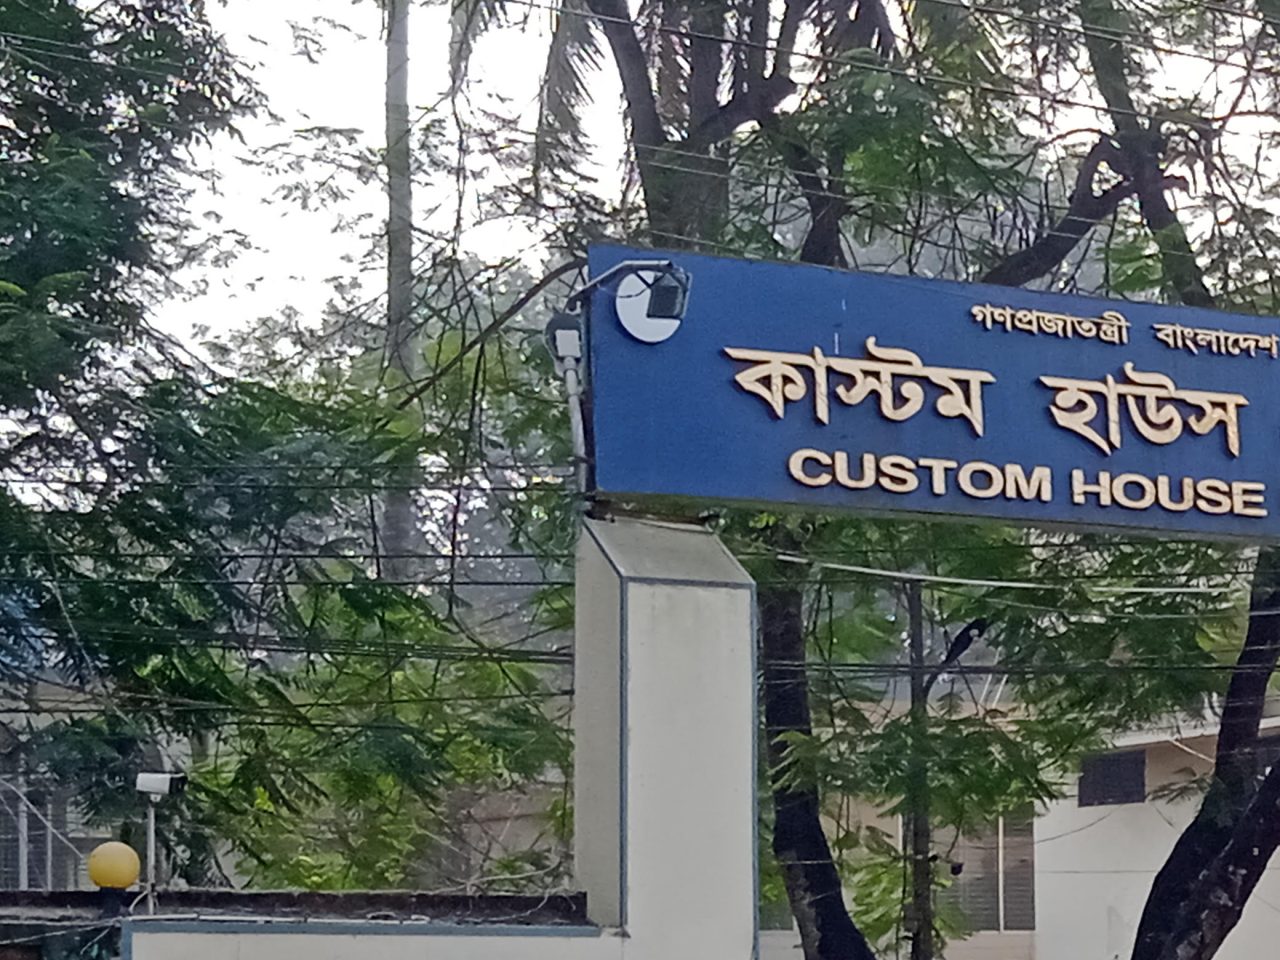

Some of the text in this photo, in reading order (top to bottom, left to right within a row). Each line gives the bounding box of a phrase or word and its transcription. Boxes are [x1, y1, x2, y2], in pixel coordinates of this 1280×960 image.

[970, 303, 1131, 346] গণপ্রজাতন্ত্রী
[1153, 322, 1279, 359] বাংলাদেশ
[723, 335, 997, 437] কাস্টম
[1039, 361, 1250, 458] হাউস
[787, 448, 1053, 502] CUSTOM
[1071, 468, 1268, 517] HOUSE
